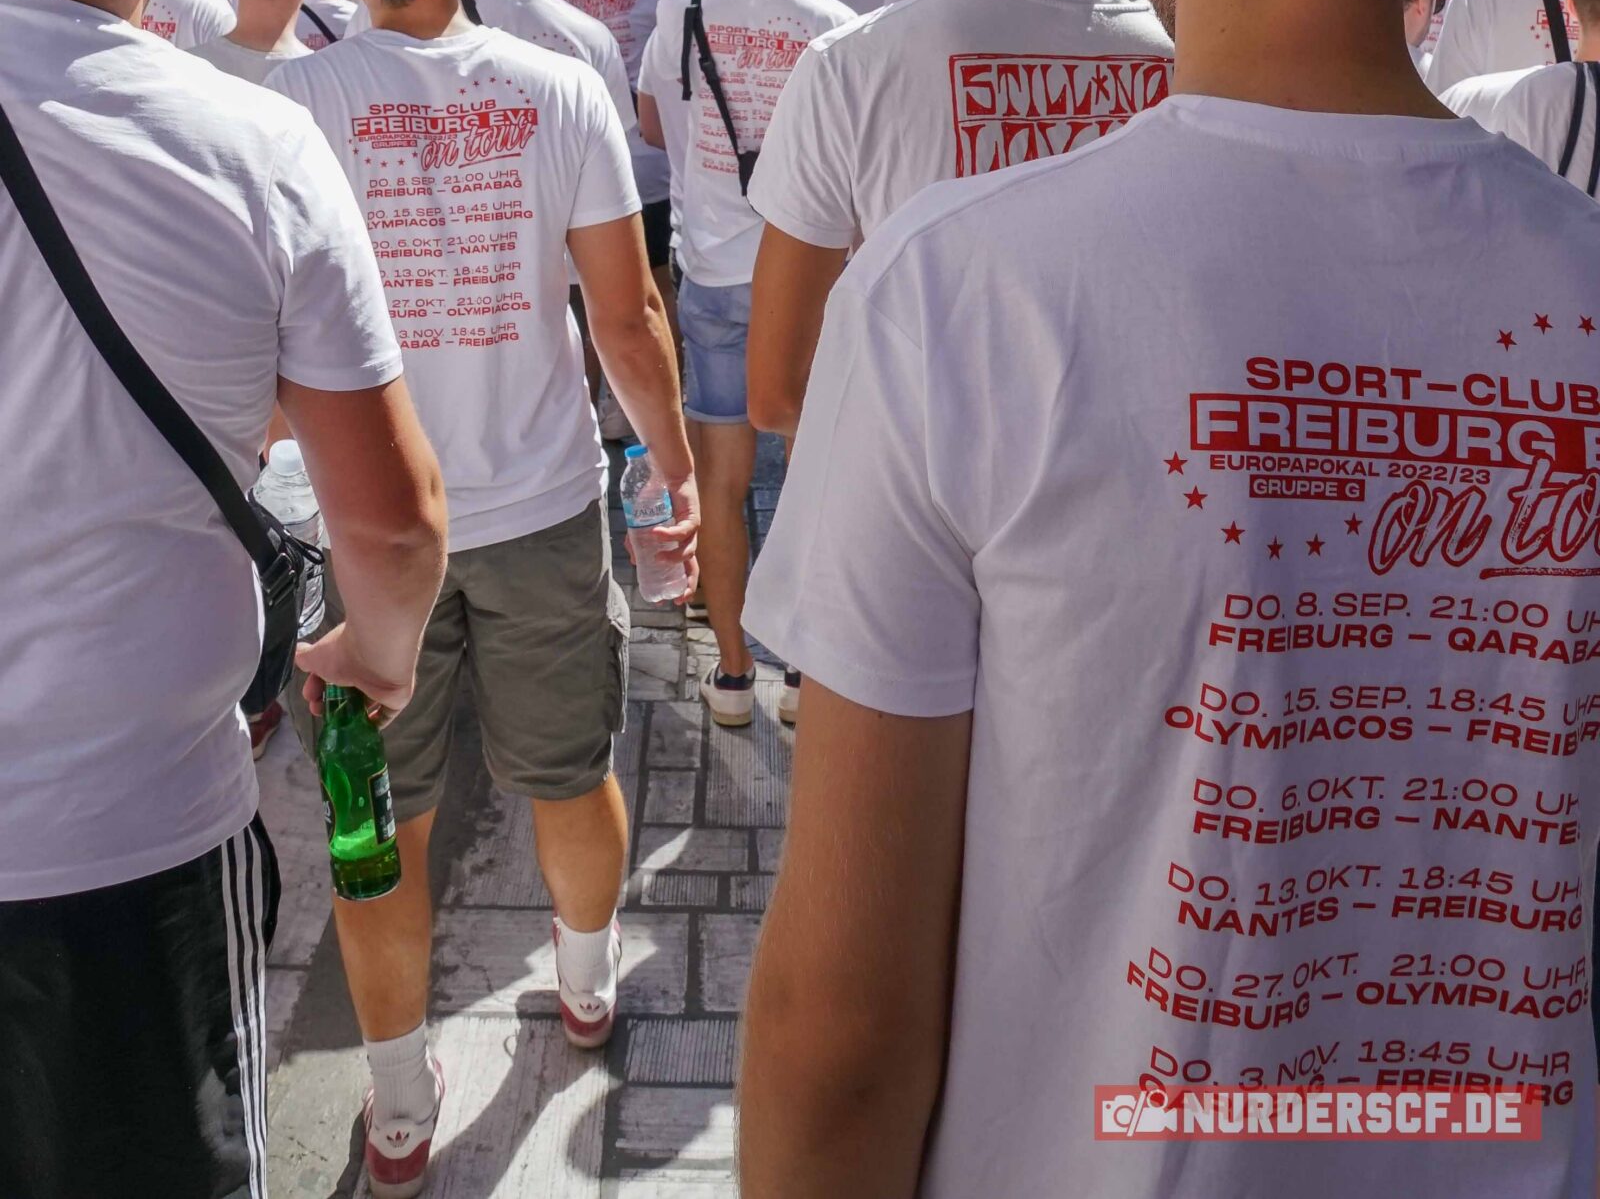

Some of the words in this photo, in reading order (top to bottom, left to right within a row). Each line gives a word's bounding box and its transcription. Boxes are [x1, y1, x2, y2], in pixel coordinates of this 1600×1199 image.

[708, 33, 777, 48] REIBURG
[960, 63, 1093, 117] STILL
[1106, 62, 1174, 116] NO
[369, 99, 497, 115] SPORT-CLUB
[354, 113, 480, 135] FREIBURG
[420, 139, 459, 171] on
[960, 120, 1129, 176] LOV
[366, 186, 433, 200] FREIBURG
[369, 179, 391, 189] DO.
[443, 172, 484, 185] 21:00
[488, 169, 519, 180] UHR
[367, 217, 446, 230] LYMPIACOS
[465, 210, 534, 223] FREIBURG
[448, 202, 489, 215] 18:45
[492, 201, 522, 211] UHR
[412, 238, 442, 248] OKT.
[447, 233, 485, 247] 21:00
[489, 231, 518, 242] UHR
[460, 241, 516, 254] NANTES
[383, 278, 434, 288] ANTES
[416, 268, 449, 278] OKT.
[453, 264, 489, 277] 18:45
[494, 262, 521, 273] UHR
[389, 309, 428, 319] BURG
[447, 301, 531, 316] OLYMPIACOS
[415, 298, 446, 309] OKT.
[495, 292, 523, 303] UHR
[400, 336, 440, 349] ABAĞ
[459, 332, 519, 347] FREIBURG
[413, 328, 445, 339] NOV.
[451, 327, 486, 337] 18:45
[490, 322, 516, 334] UHR
[1245, 356, 1600, 416] SPORT-CLUB
[1196, 399, 1557, 464] FREIBURG
[1209, 453, 1380, 478] EUROPAPOKAL
[1387, 462, 1492, 485] 2022/23
[1252, 479, 1339, 497] GRUPPE
[1343, 482, 1361, 498] G
[1368, 480, 1493, 575] on
[1224, 593, 1286, 620] DO.
[1296, 592, 1323, 617] 8.
[1332, 593, 1411, 618] SEP.
[1430, 595, 1549, 628] 21:00
[1566, 609, 1600, 634] UH
[1209, 622, 1394, 653] FREIBURG
[1447, 627, 1600, 665] QARABA
[1200, 682, 1268, 718] DO.
[1283, 688, 1320, 717] 15.
[1329, 685, 1411, 710] SEP.
[1426, 687, 1546, 722] 18:45
[1164, 705, 1413, 750] OLYMPIACOS
[1193, 777, 1264, 813] DO.
[1281, 785, 1301, 811] 6.
[1307, 776, 1385, 802] OKT.
[1402, 777, 1518, 807] 21:00
[1193, 805, 1381, 844] FREIBURG
[1432, 807, 1580, 846] NANTE
[1168, 862, 1237, 904] DO.
[1255, 878, 1299, 906] 13.
[1306, 865, 1382, 895] OKT.
[1399, 866, 1514, 896] 18:45
[1531, 879, 1580, 904] UH
[1177, 897, 1340, 938] NANTES
[1391, 895, 1583, 932] FREIBURG
[1148, 946, 1214, 993] DO.
[1232, 973, 1282, 999] 27.
[1292, 952, 1359, 989] OKT.
[1389, 953, 1506, 981] 21:00
[1522, 956, 1587, 992] UHR
[1126, 960, 1311, 1031] FREIBURG
[1150, 1045, 1219, 1087] DO.
[1239, 1067, 1269, 1091] 3.
[1278, 1042, 1340, 1086] NOV.
[1357, 1040, 1472, 1065] 18:45
[1487, 1046, 1570, 1077] UHR
